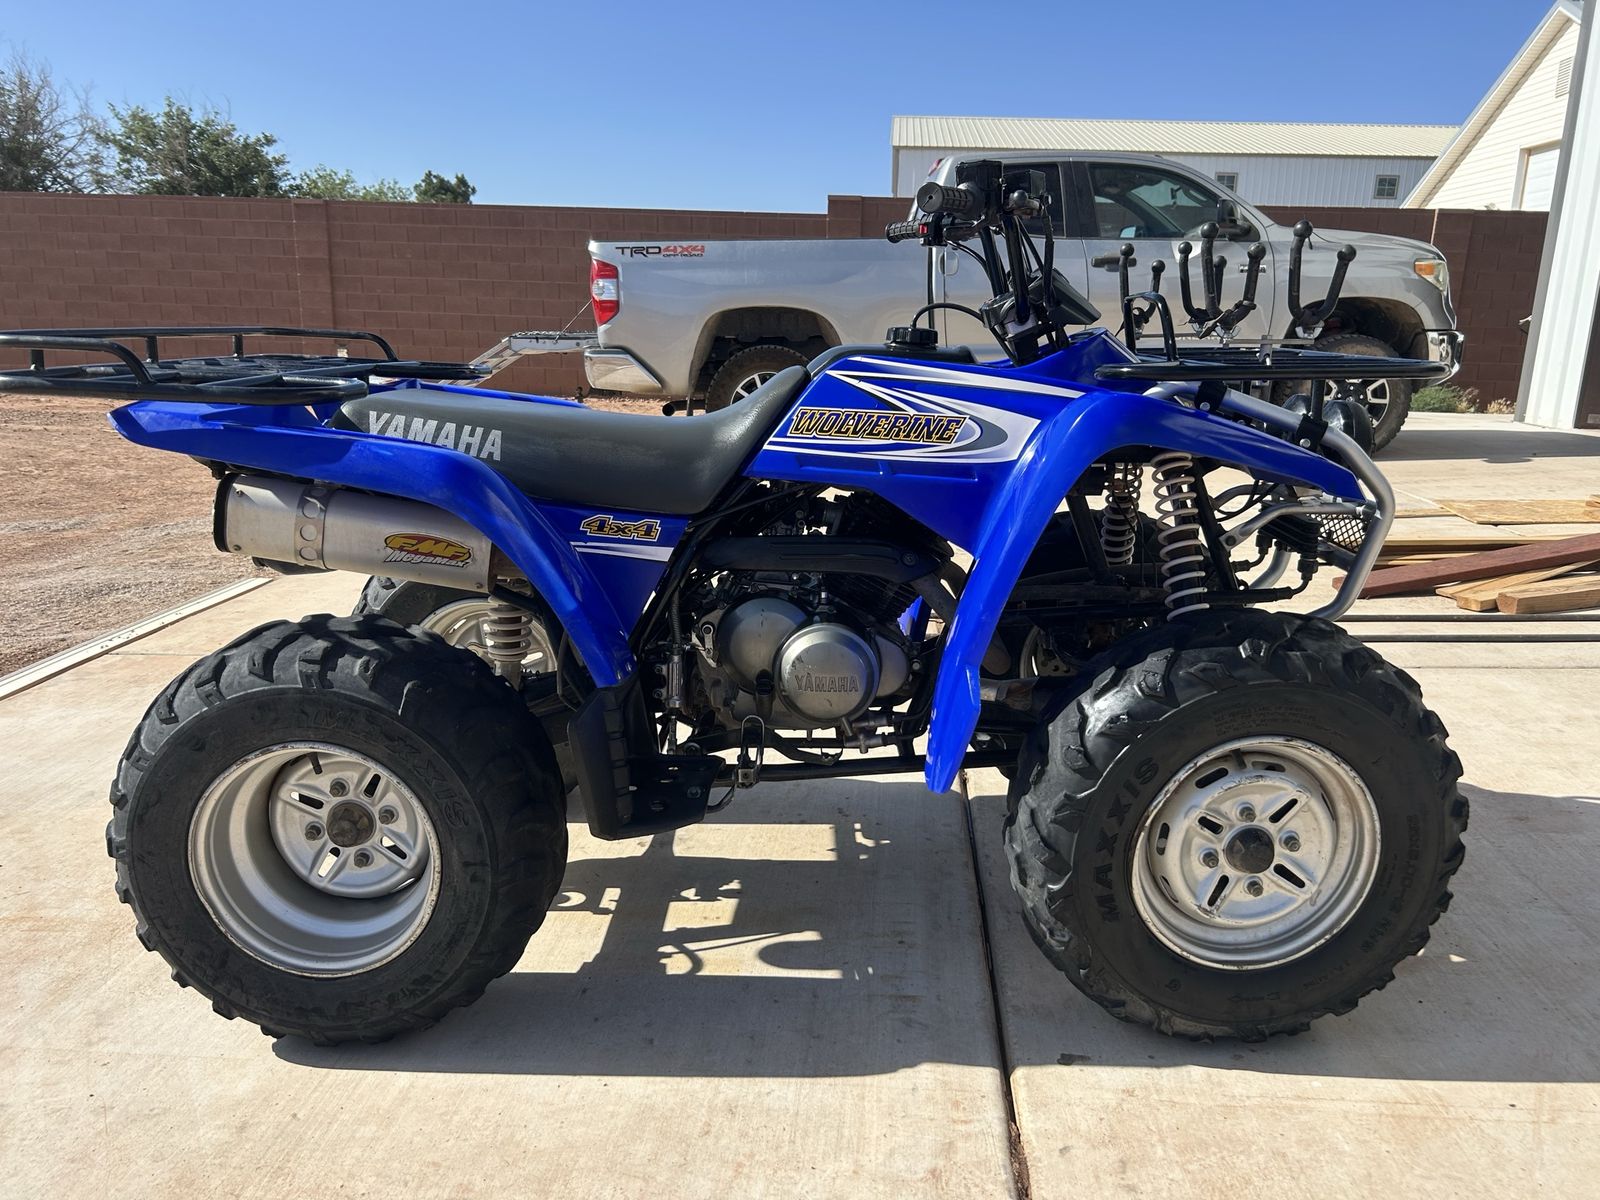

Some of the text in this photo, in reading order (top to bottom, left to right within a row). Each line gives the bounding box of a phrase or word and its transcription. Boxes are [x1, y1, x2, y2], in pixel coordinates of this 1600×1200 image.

[615, 246, 661, 257] TRD
[369, 411, 502, 461] YAMAHA
[789, 408, 967, 444] WOLVERINE
[385, 534, 471, 561] FMF
[795, 673, 859, 692] YAMAHA
[1095, 757, 1159, 922] MAXXIS
